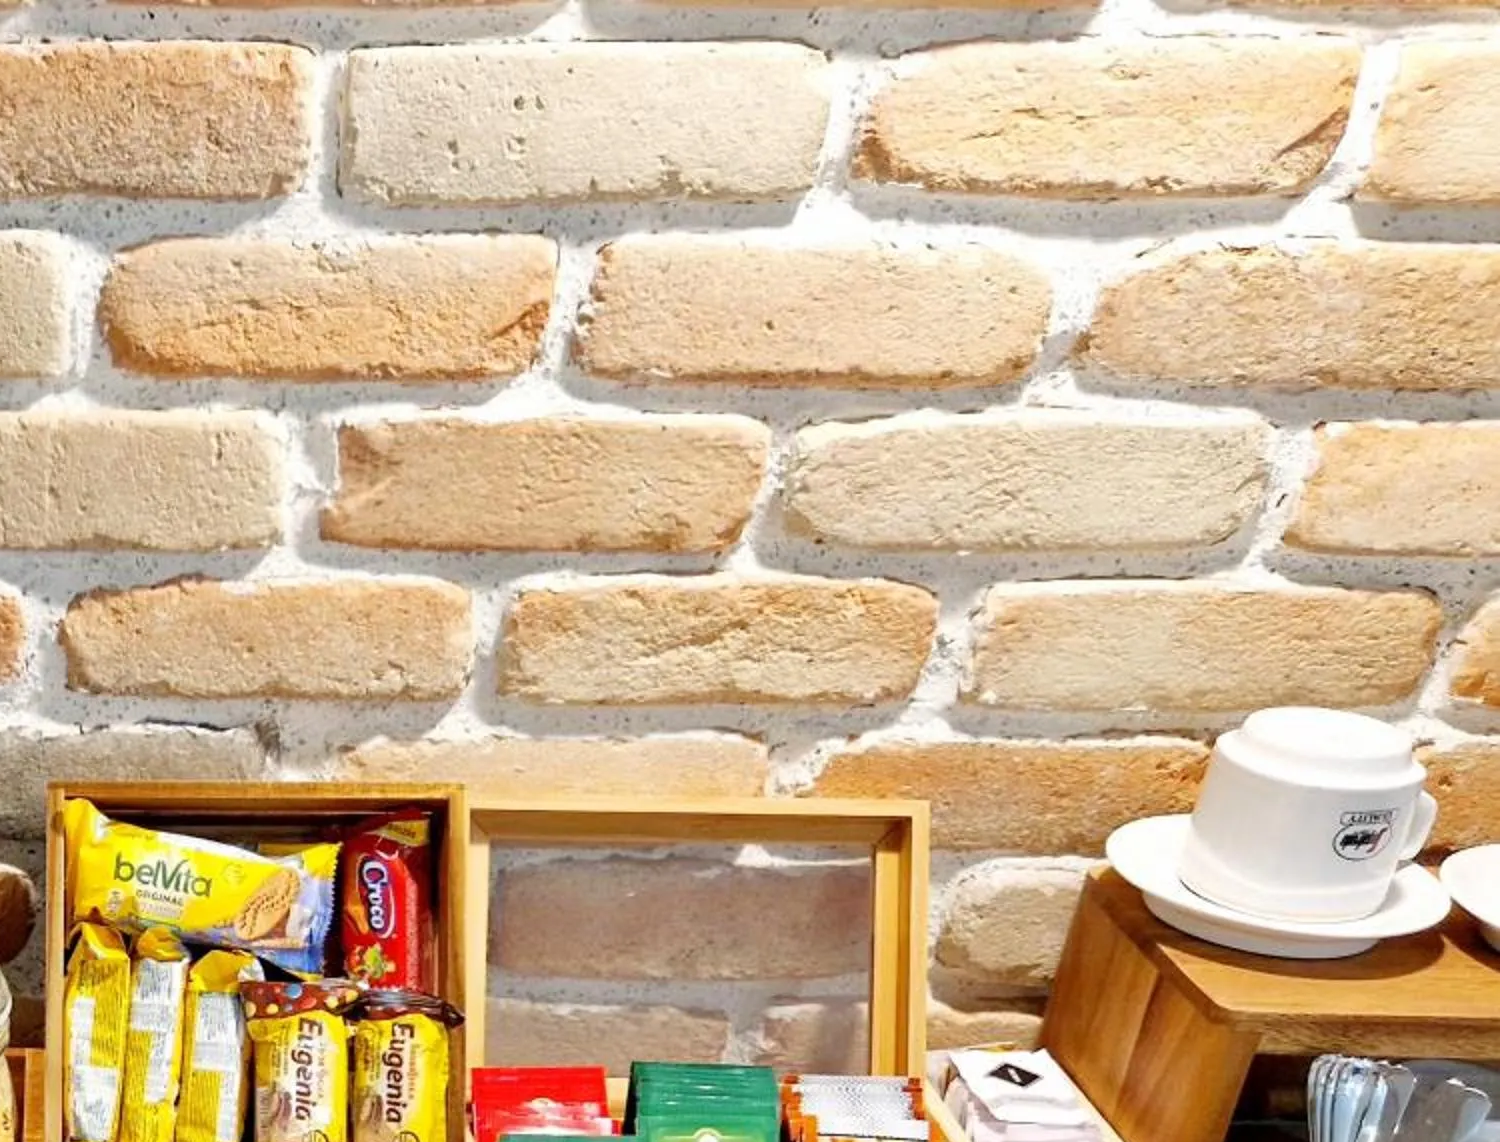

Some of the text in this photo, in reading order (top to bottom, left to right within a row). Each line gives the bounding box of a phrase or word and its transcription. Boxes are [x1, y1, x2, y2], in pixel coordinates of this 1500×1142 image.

[113, 852, 213, 898] belVita
[360, 860, 389, 930] Croco
[291, 1017, 324, 1122] Eugenia
[381, 1022, 415, 1124] Eugenia
